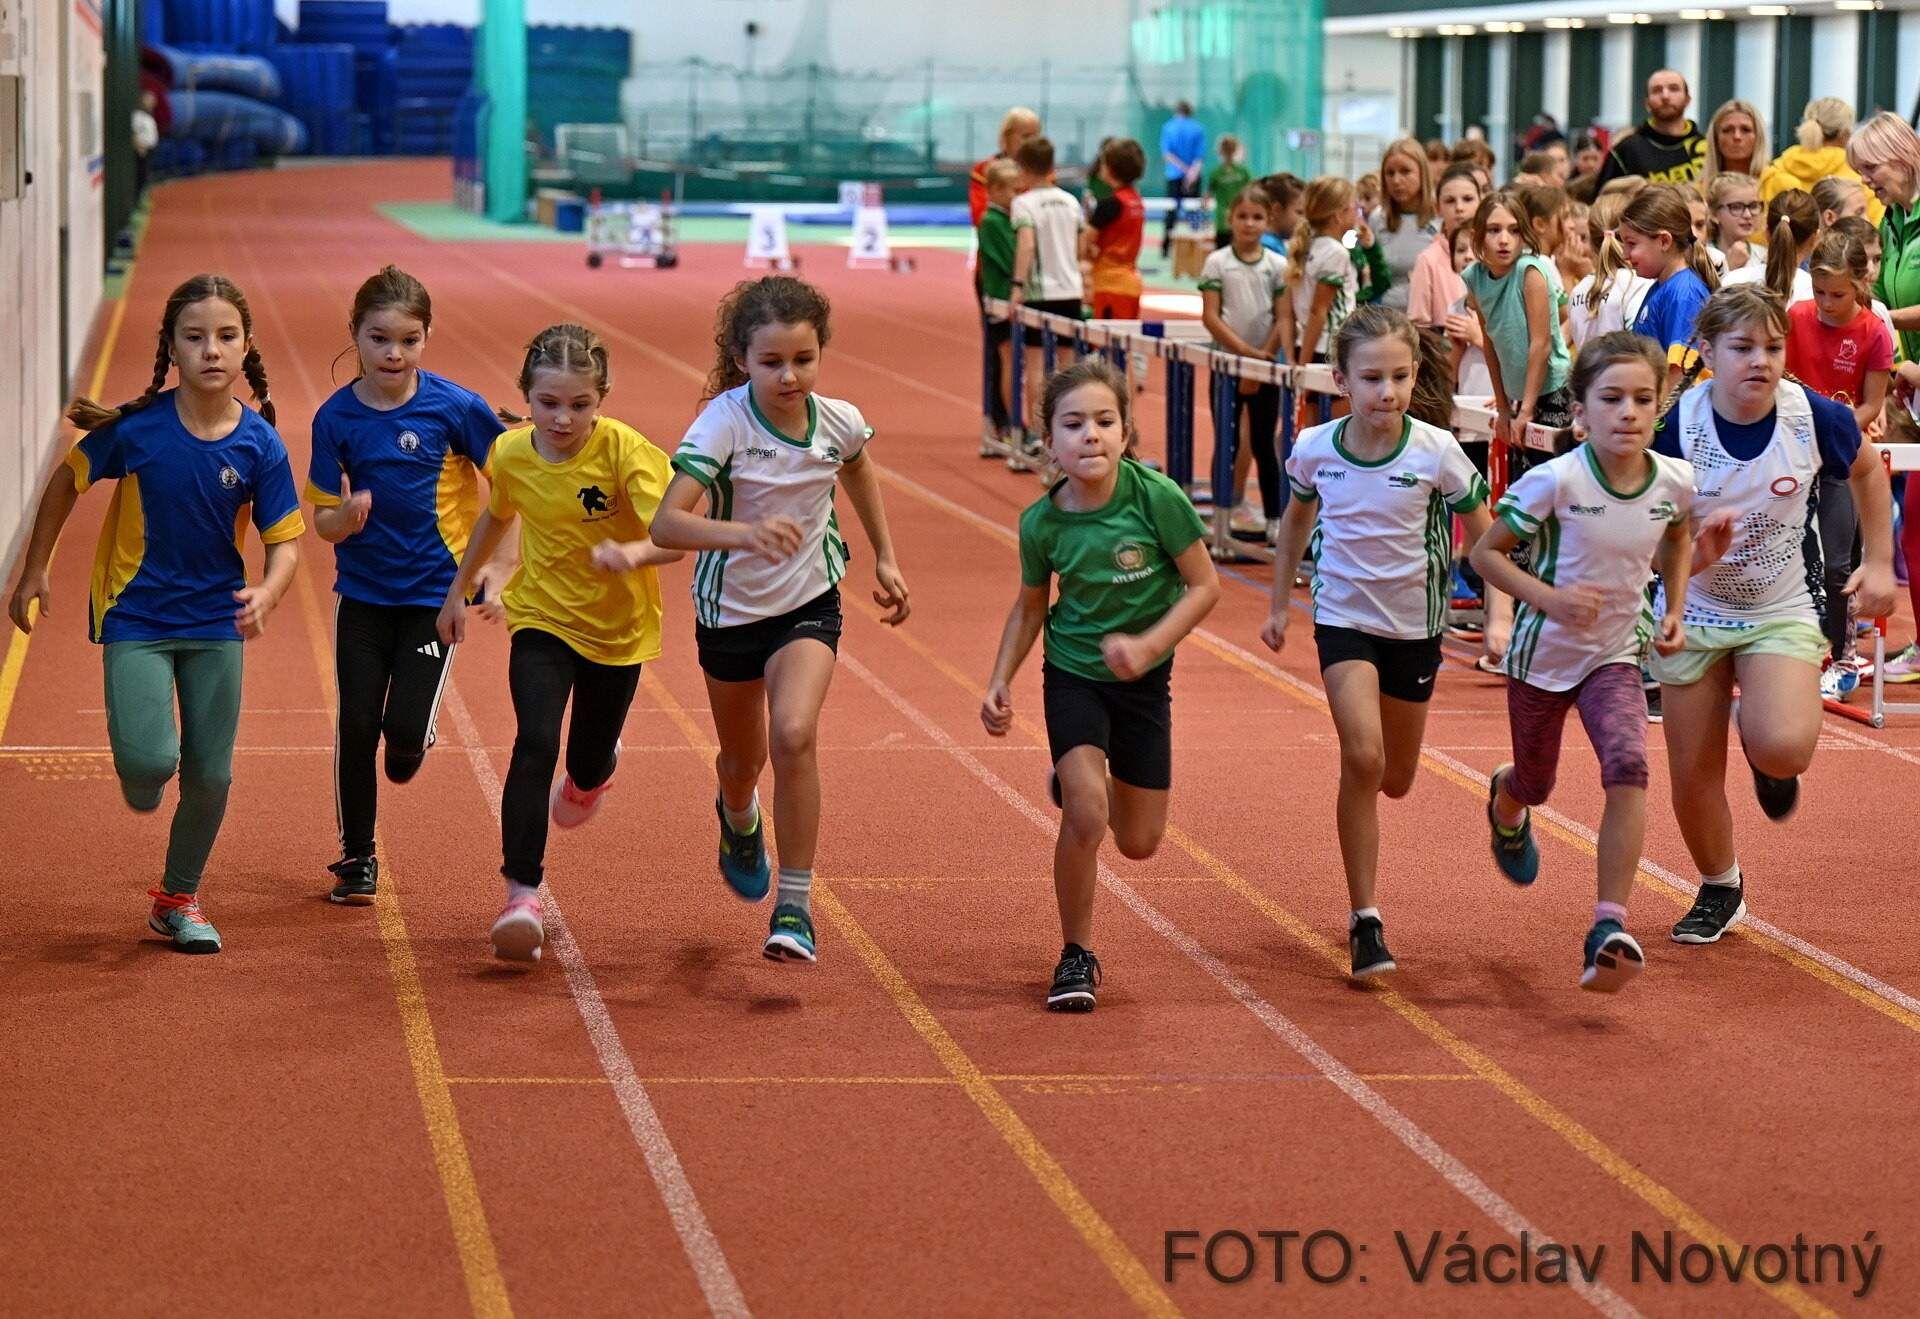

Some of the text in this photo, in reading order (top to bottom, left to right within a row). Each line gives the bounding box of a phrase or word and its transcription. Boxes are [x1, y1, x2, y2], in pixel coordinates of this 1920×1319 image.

[760, 225, 775, 251] 3
[863, 226, 878, 251] 2
[1112, 566, 1154, 584] ATLETIKA
